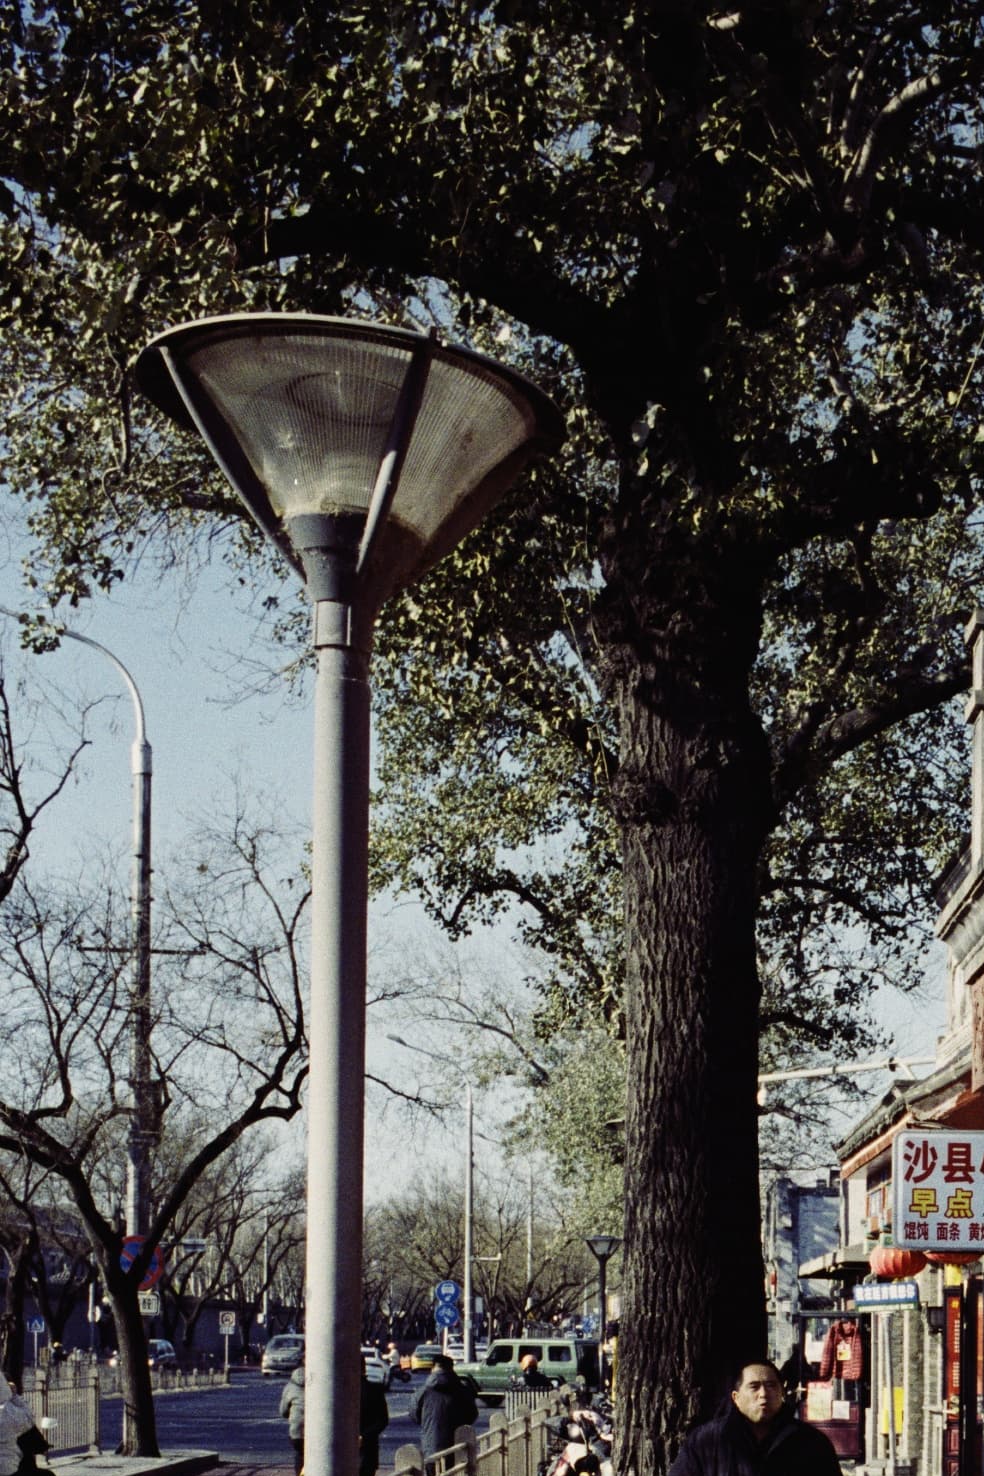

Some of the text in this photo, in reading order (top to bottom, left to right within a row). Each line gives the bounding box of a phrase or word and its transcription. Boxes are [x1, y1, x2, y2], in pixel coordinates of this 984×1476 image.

[909, 1187, 975, 1219] 早点
[903, 1220, 930, 1240] 馄饨
[936, 1222, 961, 1241] 面条
